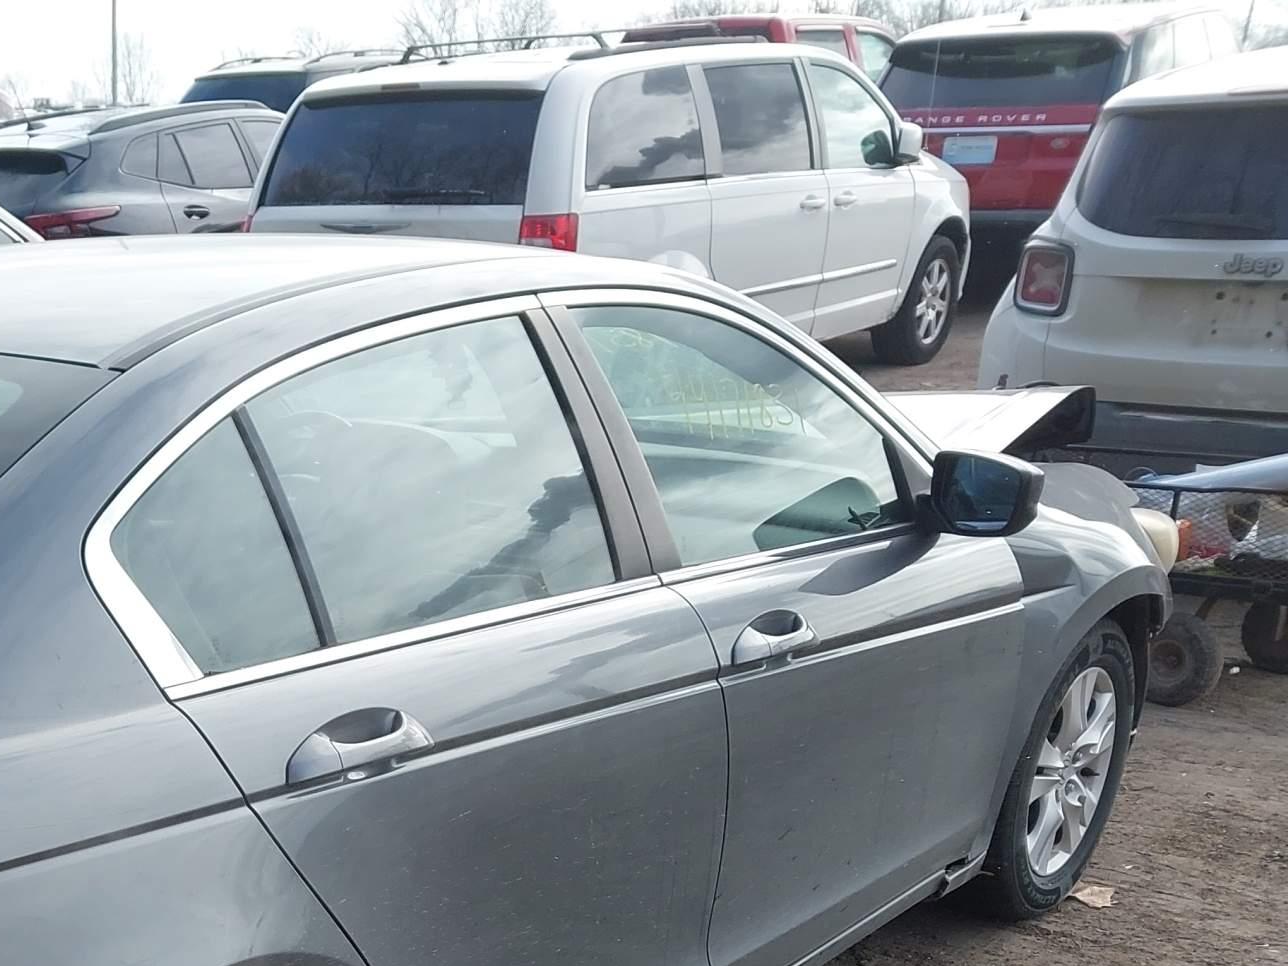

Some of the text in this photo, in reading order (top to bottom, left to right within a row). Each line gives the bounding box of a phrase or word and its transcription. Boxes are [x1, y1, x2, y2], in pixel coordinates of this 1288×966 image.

[902, 113, 1048, 124] RANGE ROVER
[1223, 252, 1285, 278] Jeep
